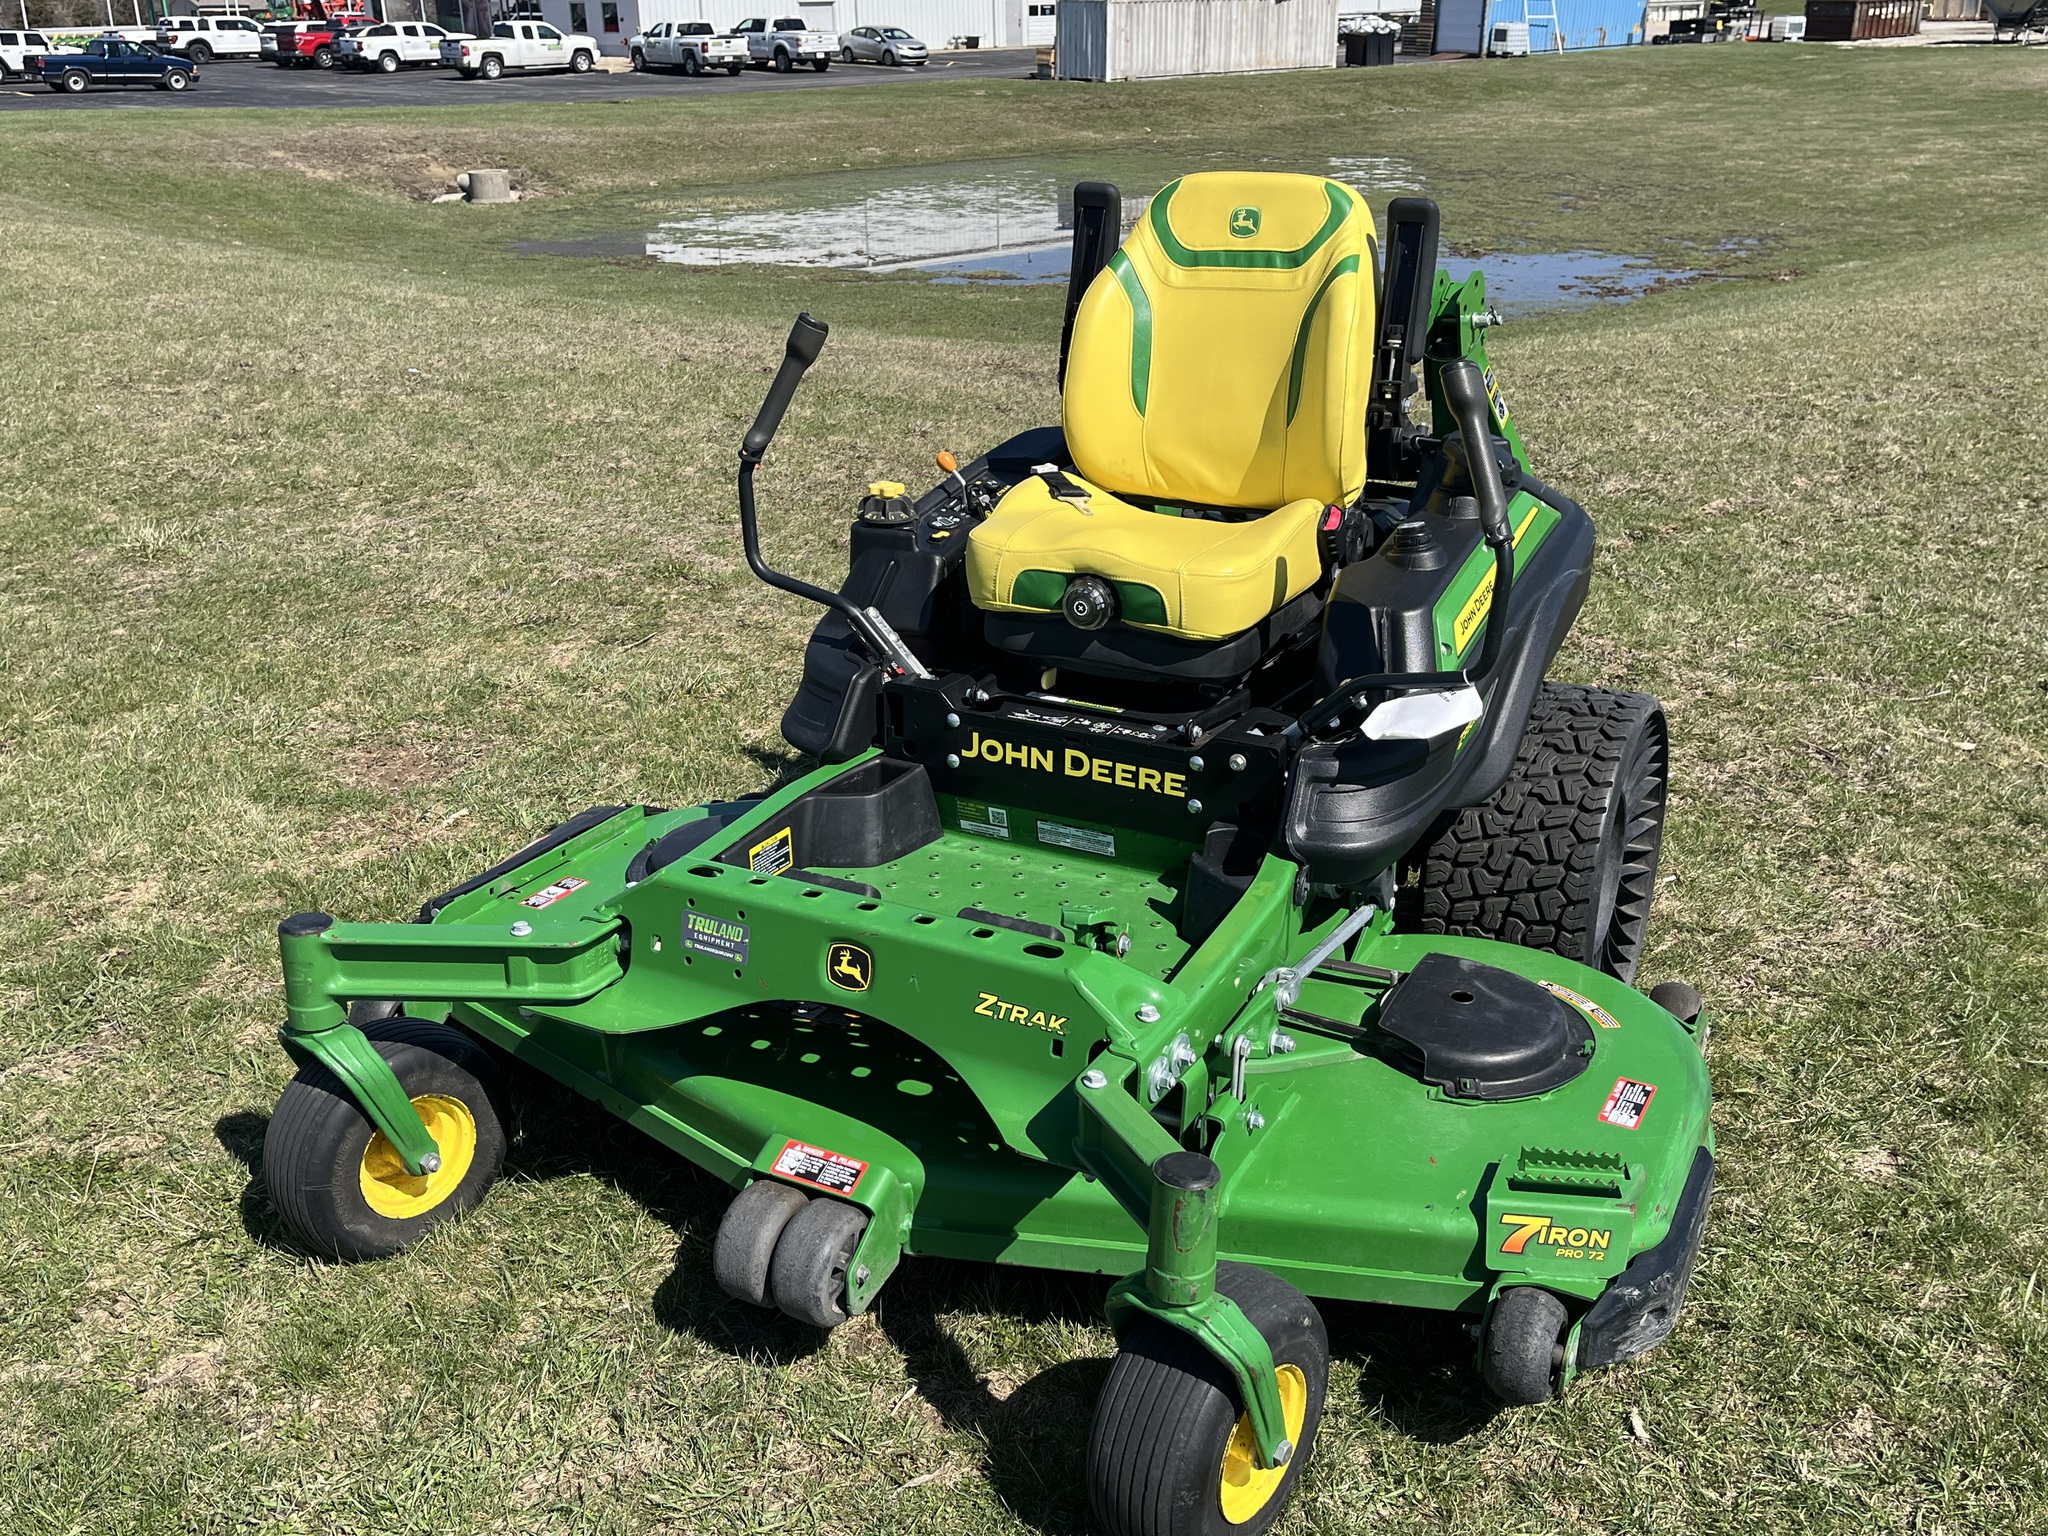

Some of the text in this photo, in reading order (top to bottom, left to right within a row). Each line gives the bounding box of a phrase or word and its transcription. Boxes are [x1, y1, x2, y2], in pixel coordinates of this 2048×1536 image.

[1460, 607, 1477, 636] JOHN
[961, 732, 1187, 798] JOHN DEERE
[688, 913, 744, 942] TRULAND
[693, 932, 735, 949] EQUIPMENT
[974, 991, 1069, 1036] ZTRAK
[1556, 1248, 1605, 1261] PRO 72
